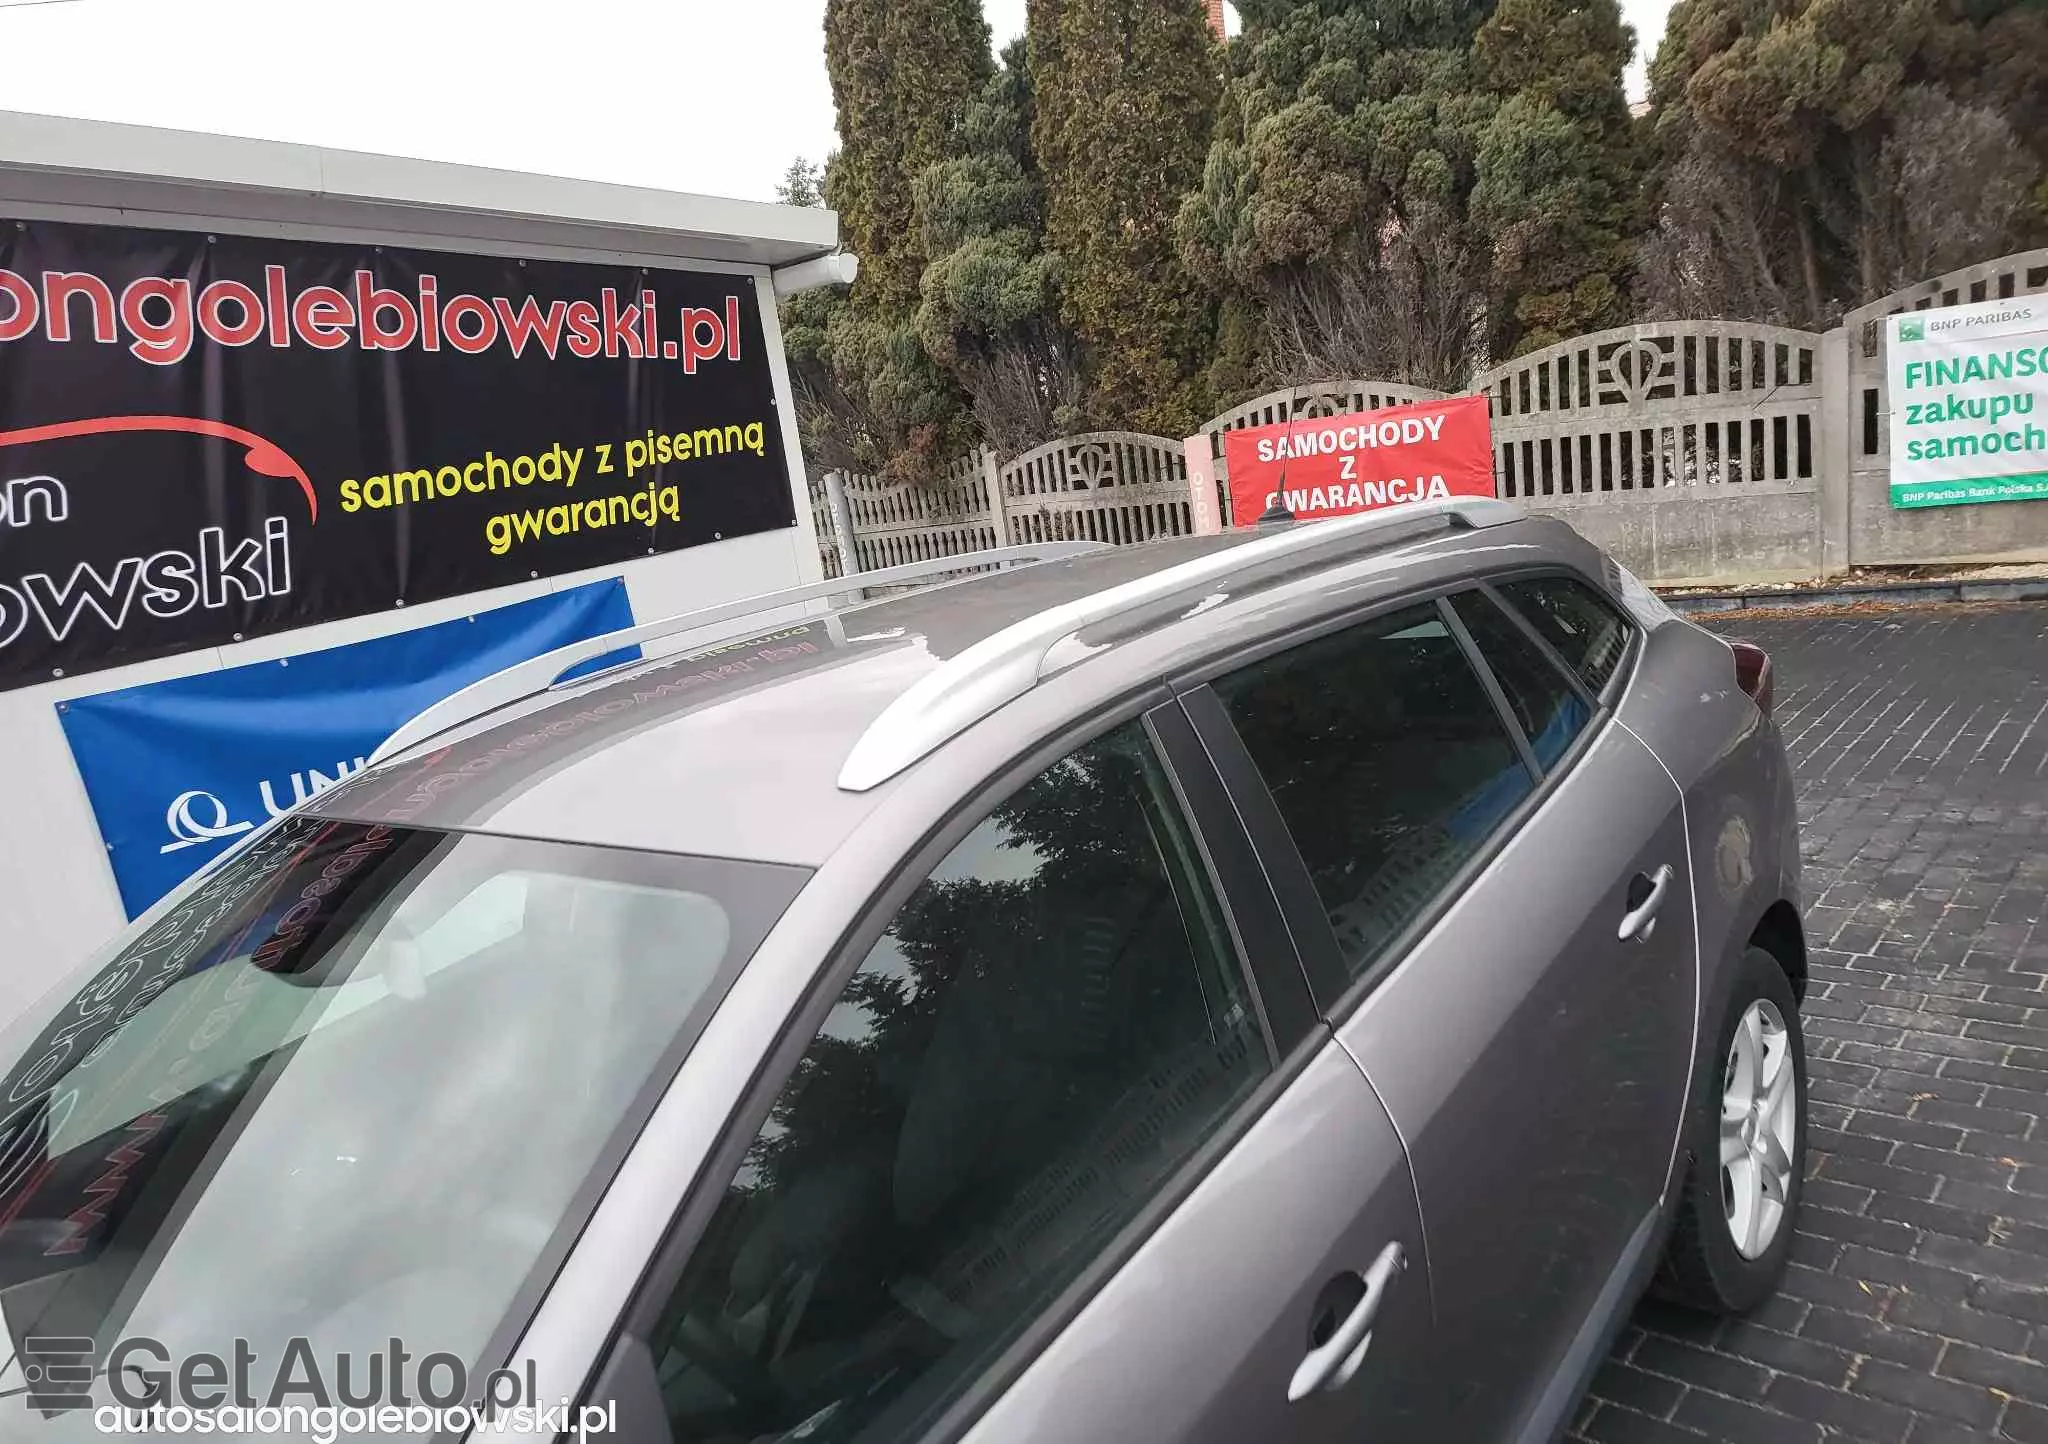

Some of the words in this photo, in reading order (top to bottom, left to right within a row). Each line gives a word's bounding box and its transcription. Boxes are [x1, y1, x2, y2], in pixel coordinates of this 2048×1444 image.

[1930, 319, 1961, 332] BNP
[1966, 308, 2032, 327] PARIBAS
[1906, 393, 2033, 425] zakupu
[1257, 415, 1447, 462] SAMOCHODY
[1907, 423, 2046, 460] samoch
[340, 442, 583, 514] samochody
[596, 442, 613, 473] z
[624, 421, 764, 477] pisemną
[1339, 456, 1357, 480] Z
[1903, 493, 1924, 502] BNP
[1928, 489, 1966, 500] Paribas
[1969, 487, 1996, 497] Bank
[485, 482, 680, 554] gwarancją
